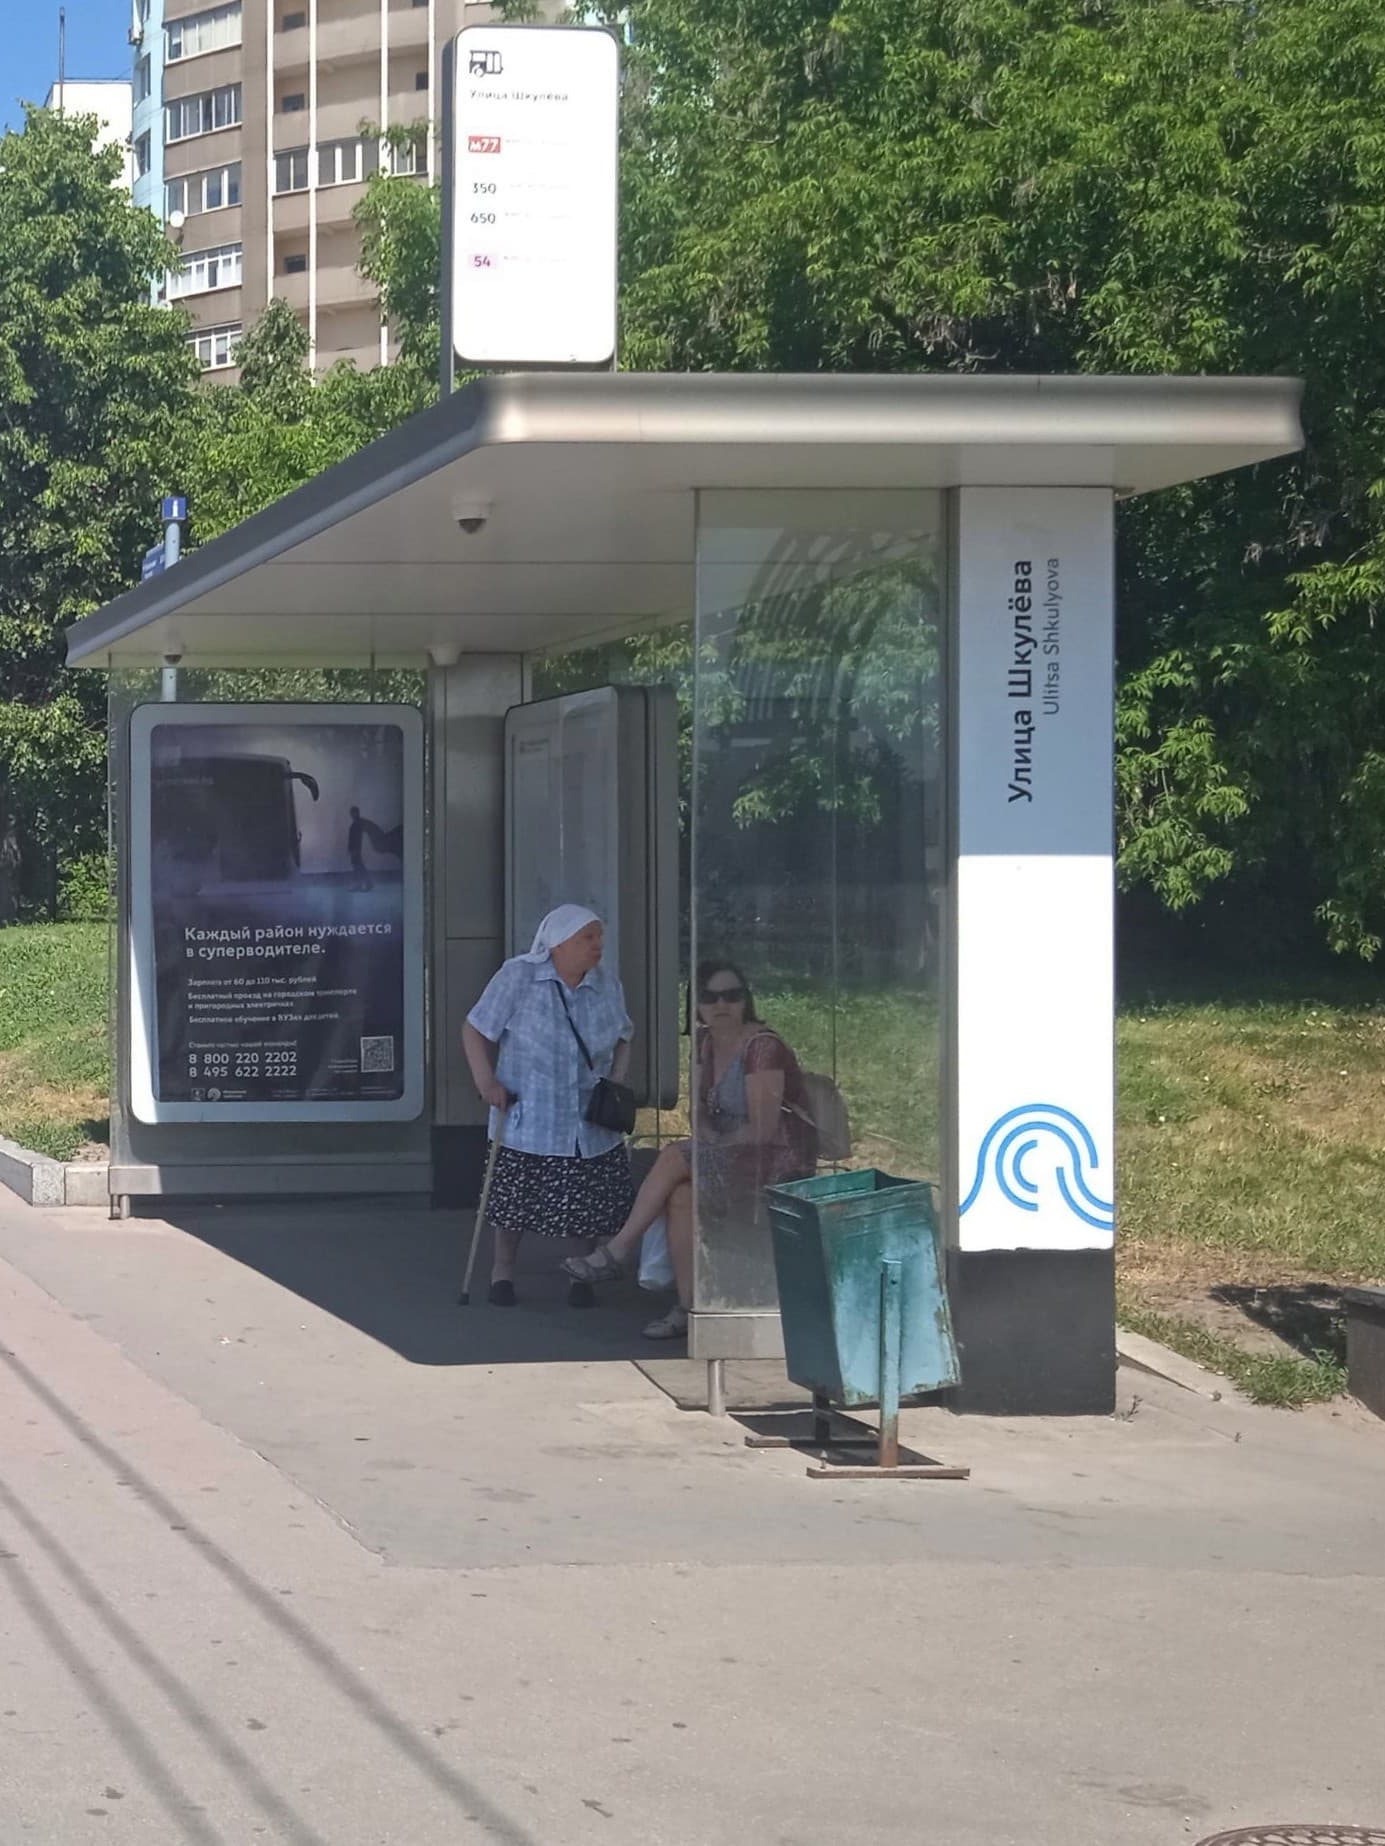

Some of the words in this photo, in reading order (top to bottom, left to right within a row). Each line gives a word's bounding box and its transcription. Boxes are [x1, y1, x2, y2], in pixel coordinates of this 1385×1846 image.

[472, 181, 497, 195] 350
[470, 212, 496, 224] 650
[473, 255, 491, 268] 54
[1042, 557, 1063, 655] Shkulyova
[1007, 559, 1038, 698] Шкулёва
[1042, 660, 1060, 715] Ulitsa
[1007, 709, 1036, 803] Улица
[184, 926, 251, 942] Каждый
[254, 925, 304, 942] район
[308, 922, 392, 939] нуждается
[186, 948, 194, 958] в
[198, 942, 326, 961] суперводителе.
[256, 977, 270, 986] 110
[189, 1054, 197, 1064] 8
[204, 1053, 229, 1065] 800
[235, 1052, 260, 1064] 220
[265, 1051, 297, 1063] 2202
[189, 1067, 197, 1078] 8
[203, 1066, 228, 1077] 495
[235, 1066, 259, 1077] 622
[265, 1065, 297, 1077] 2222
